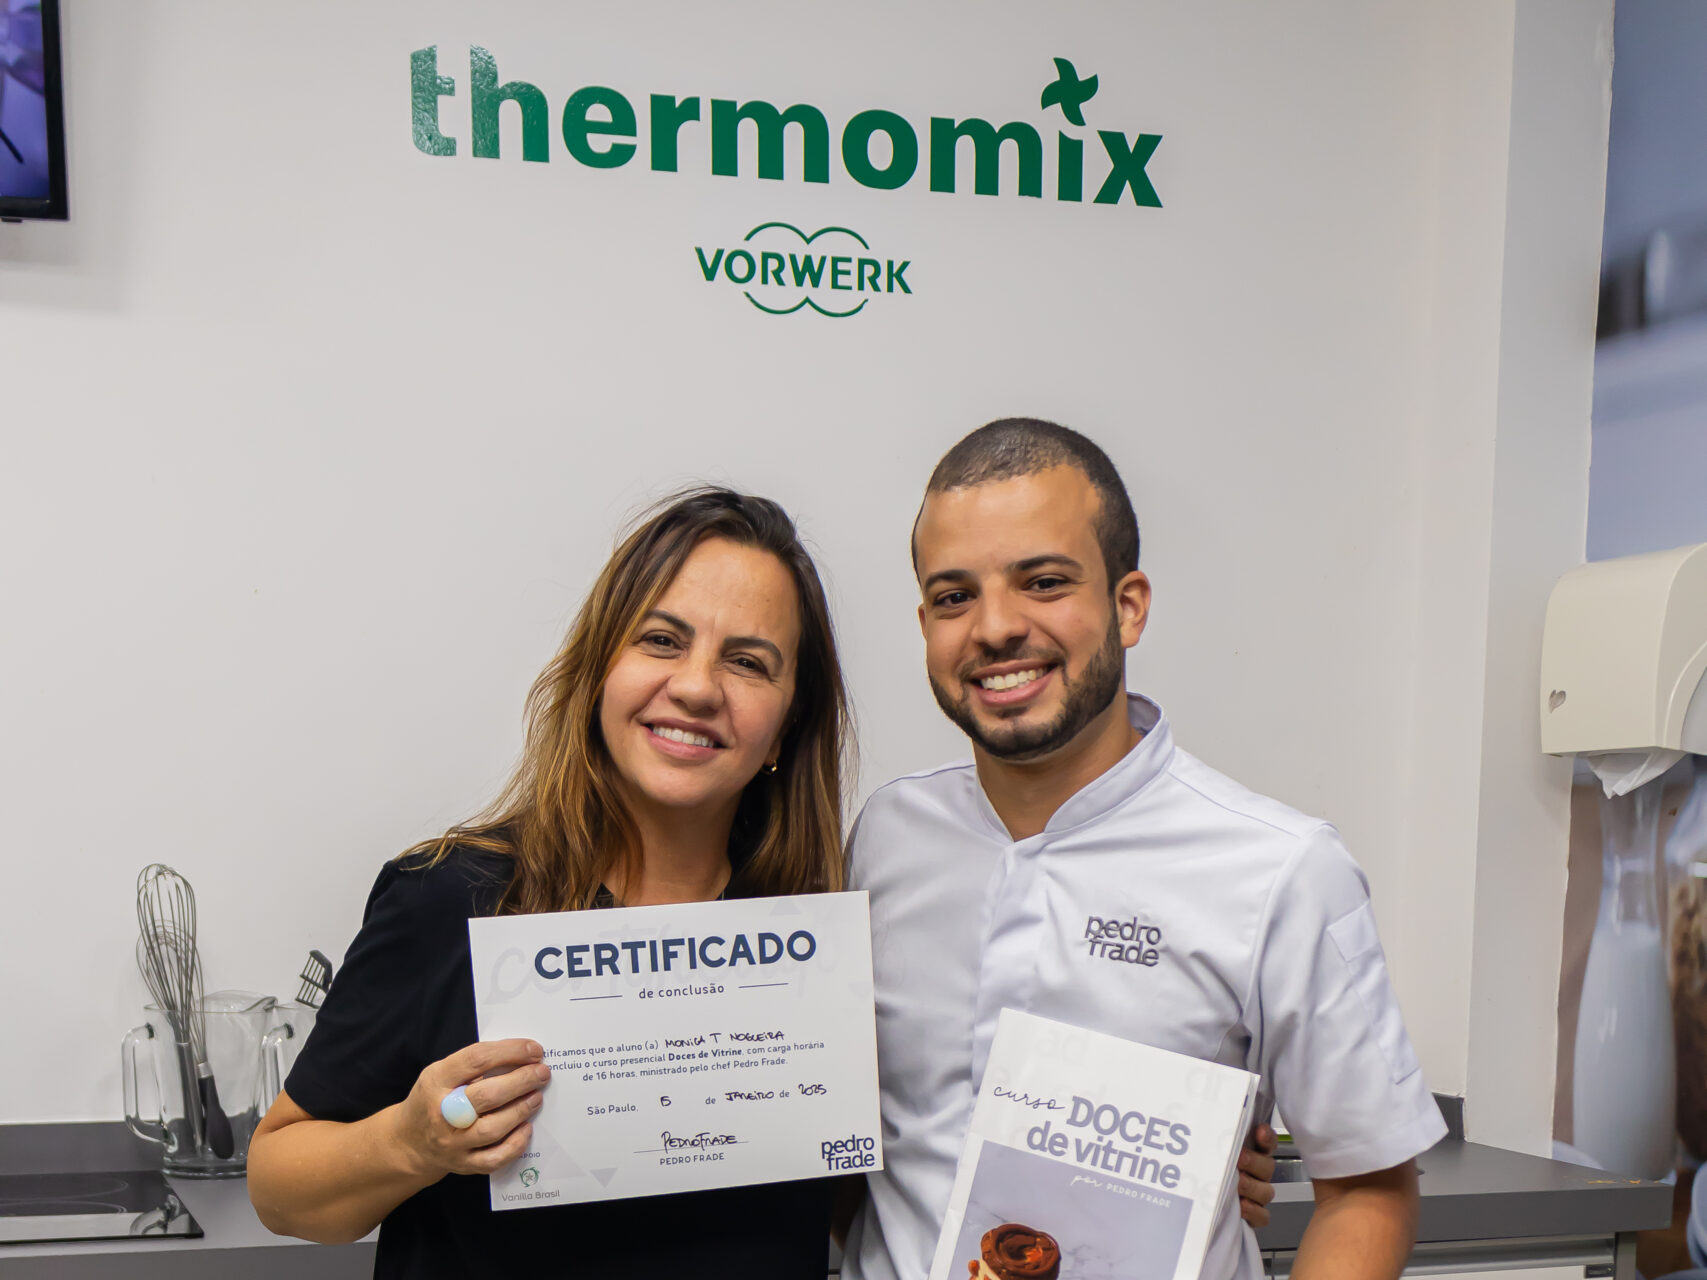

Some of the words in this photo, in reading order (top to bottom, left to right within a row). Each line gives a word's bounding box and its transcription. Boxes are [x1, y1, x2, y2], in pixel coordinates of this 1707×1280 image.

[410, 44, 1164, 208] thermomix
[694, 246, 912, 294] VORWERK
[1084, 916, 1161, 946] pedro
[534, 930, 817, 980] CERTIFICADO
[1088, 934, 1160, 967] frade
[639, 987, 655, 999] de
[658, 982, 725, 998] conclusão
[543, 1049, 587, 1058] tificamos
[588, 1047, 606, 1056] que
[608, 1045, 614, 1053] o
[616, 1043, 643, 1052] aluno
[645, 1040, 659, 1051] (a)
[709, 1032, 722, 1044] T
[548, 1060, 582, 1071] oncluiu
[592, 1059, 618, 1067] curso
[620, 1053, 666, 1067] presencial
[668, 1052, 696, 1062] Doces
[698, 1050, 709, 1059] de
[746, 1047, 766, 1055] com
[767, 1044, 791, 1054] carga
[793, 1041, 825, 1051] horária
[582, 1071, 594, 1081] de
[596, 1072, 607, 1080] 16
[639, 1065, 688, 1077] ministrado
[690, 1063, 709, 1075] pelo
[711, 1060, 731, 1071] chef
[733, 1059, 759, 1069] Pedro
[587, 1106, 606, 1115] São
[705, 1096, 717, 1105] de
[779, 1089, 790, 1098] de
[798, 1083, 828, 1096] 2025
[1066, 1095, 1192, 1156] DOCES
[659, 1155, 692, 1166] PEDRO
[693, 1152, 725, 1163] FRADE
[821, 1133, 875, 1160] pedro
[826, 1149, 876, 1171] frade
[1026, 1120, 1069, 1157] de
[1075, 1136, 1181, 1189] vitrine
[501, 1192, 533, 1202] Vanilla
[535, 1190, 560, 1200] Brasil
[1106, 1183, 1138, 1198] PEDRO
